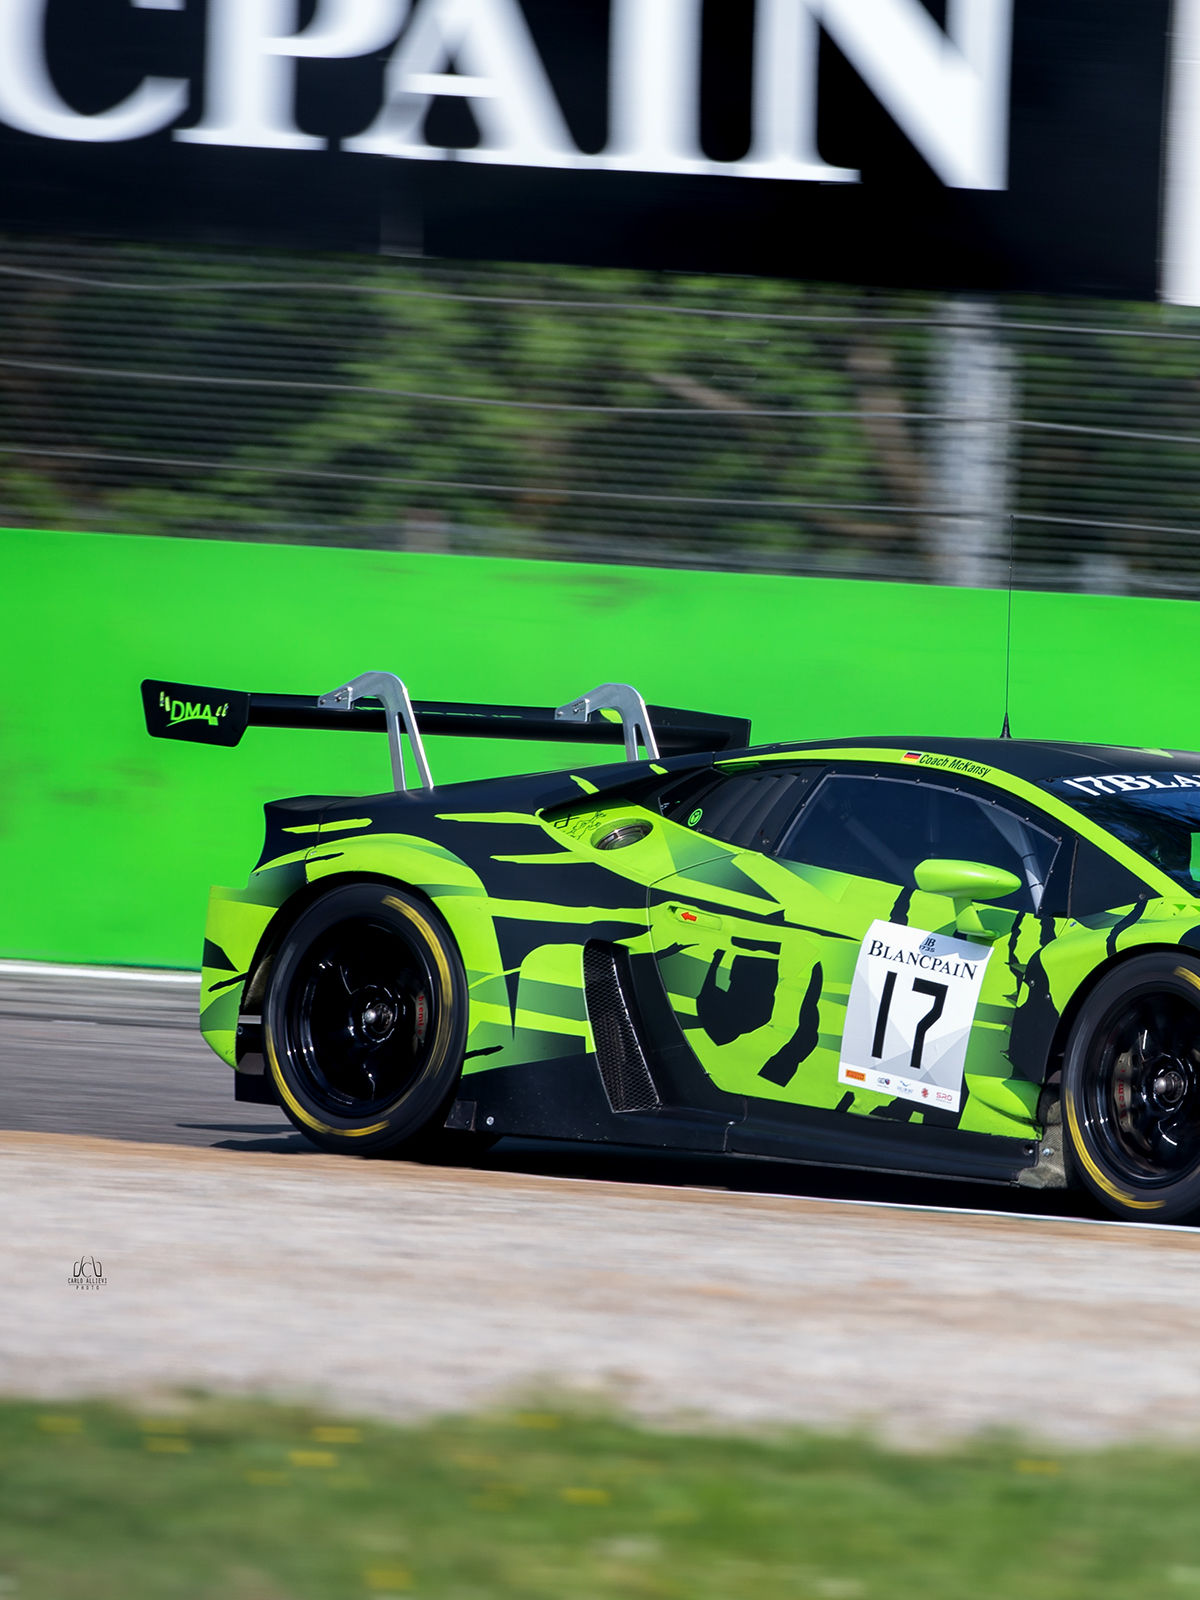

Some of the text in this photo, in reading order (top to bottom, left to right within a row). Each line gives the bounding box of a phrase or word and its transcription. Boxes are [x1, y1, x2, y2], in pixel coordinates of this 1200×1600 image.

[919, 754, 991, 778] Coach McKansy
[867, 940, 978, 981] BLANCPAIN
[871, 970, 949, 1069] 17
